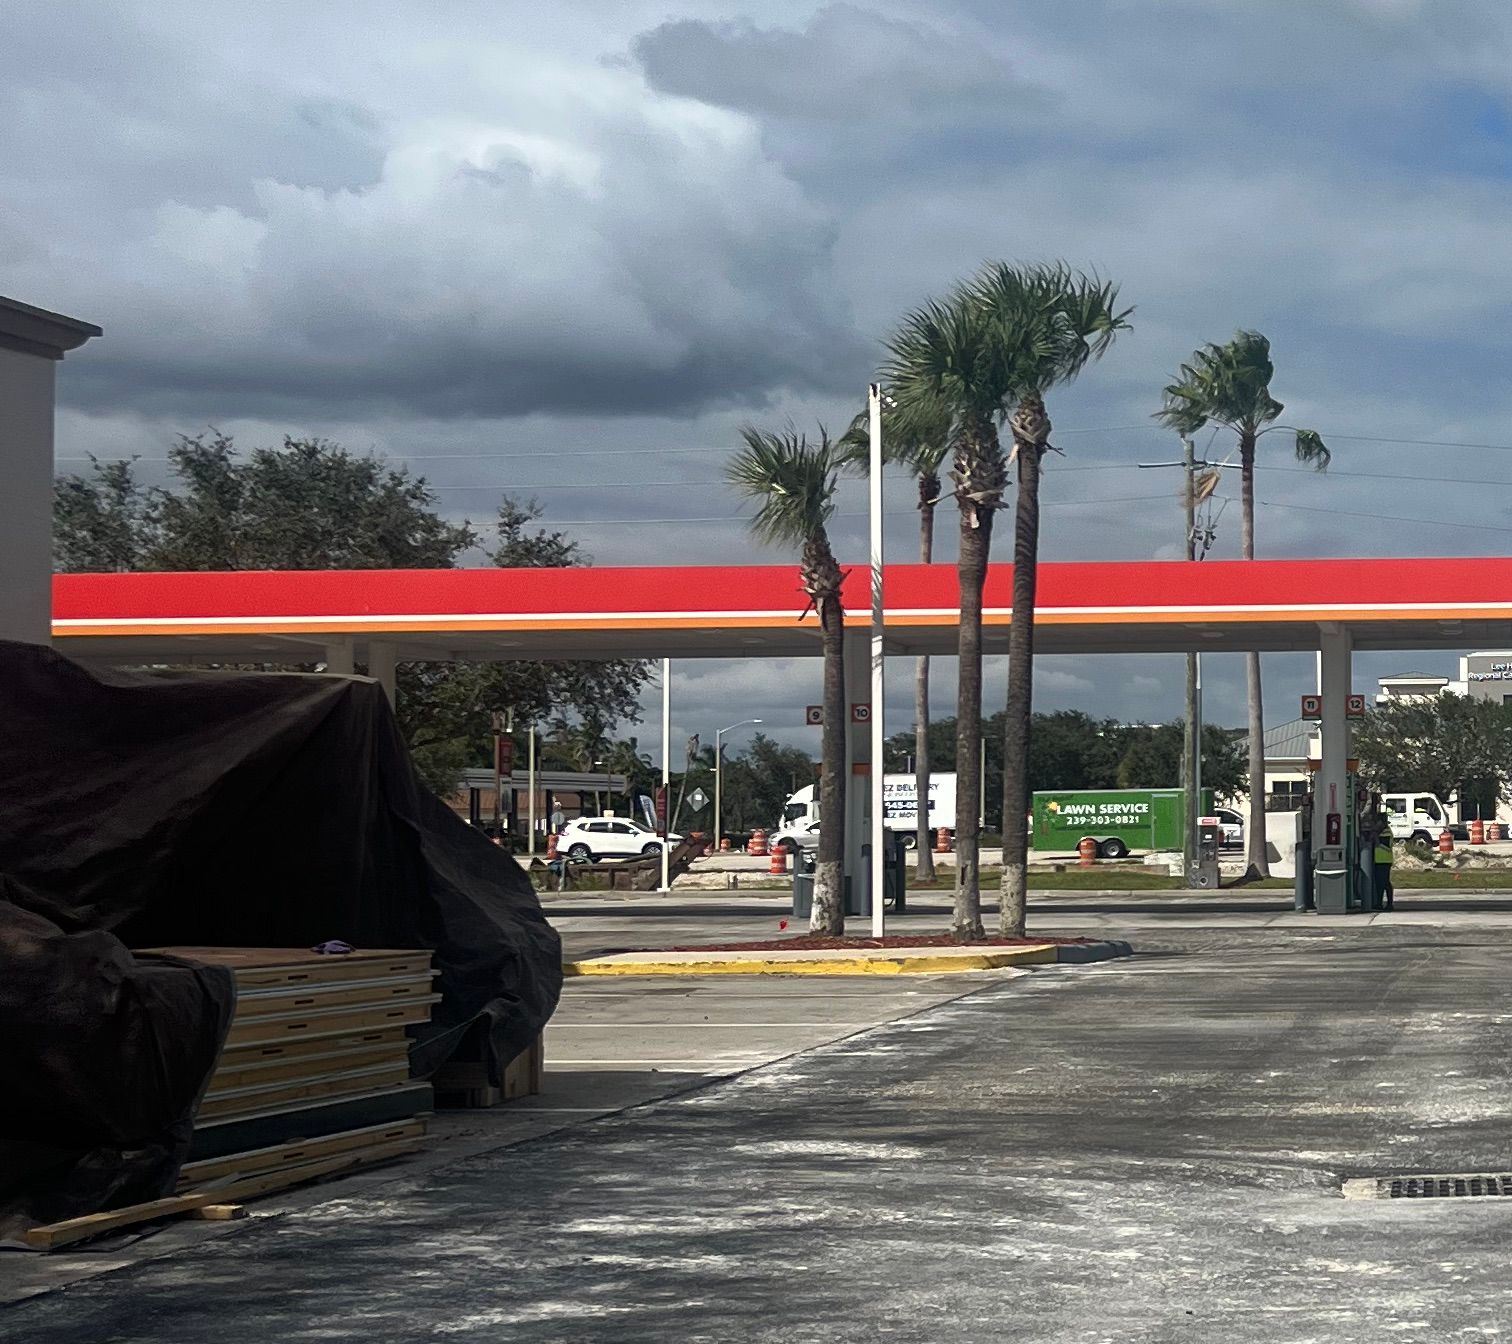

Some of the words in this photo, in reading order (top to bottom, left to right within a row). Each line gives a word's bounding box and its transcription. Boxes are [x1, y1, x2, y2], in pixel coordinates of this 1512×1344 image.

[1490, 662, 1505, 670] Lee
[1468, 671, 1501, 681] Regional
[1307, 700, 1315, 709] 11
[1350, 700, 1361, 709] 12
[811, 711, 820, 720] 9
[856, 708, 868, 717] 10
[1056, 804, 1096, 815] LAWN
[1099, 803, 1149, 814] SERVICE
[1066, 815, 1140, 826] 239-303-0821
